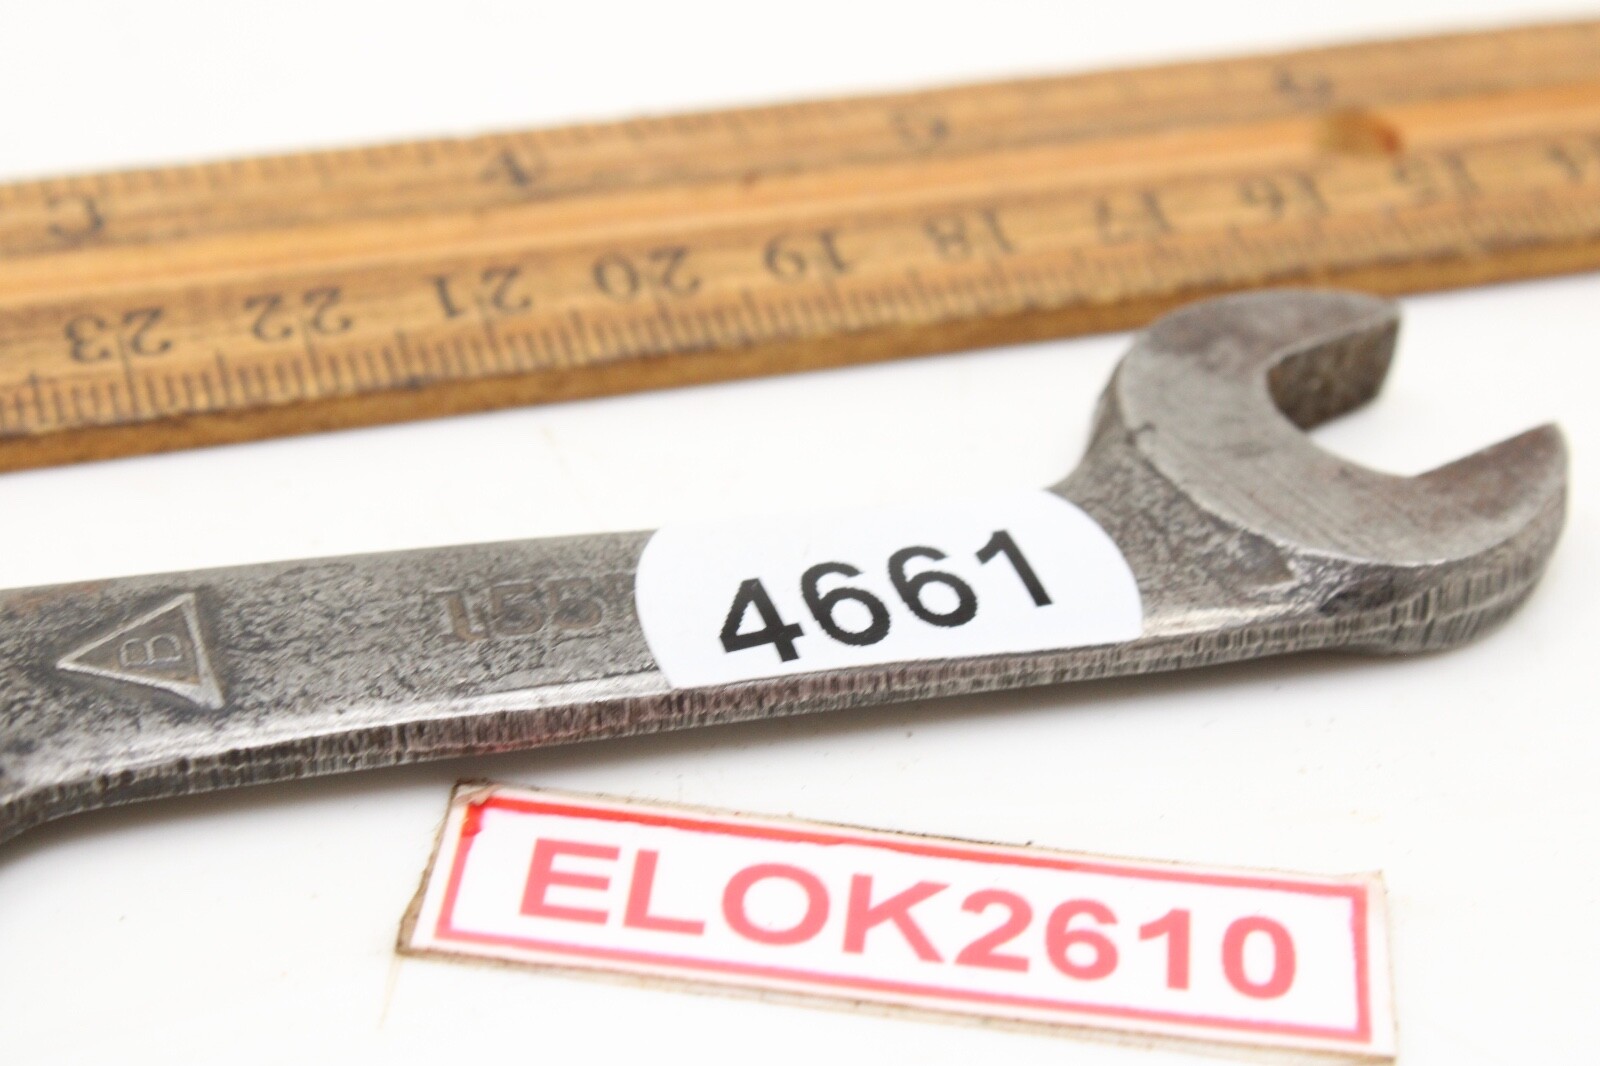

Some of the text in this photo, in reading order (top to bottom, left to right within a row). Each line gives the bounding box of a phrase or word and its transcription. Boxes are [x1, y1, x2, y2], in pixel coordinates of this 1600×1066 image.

[922, 207, 1019, 262] 18
[1093, 187, 1174, 246] 17
[593, 245, 703, 300] 20
[763, 227, 855, 280] 19
[245, 285, 353, 343] 22
[424, 265, 533, 320] 21
[64, 306, 173, 365] 23
[719, 529, 1054, 663] 4661
[119, 632, 183, 667] B
[518, 837, 1299, 1001] ELOK2610
